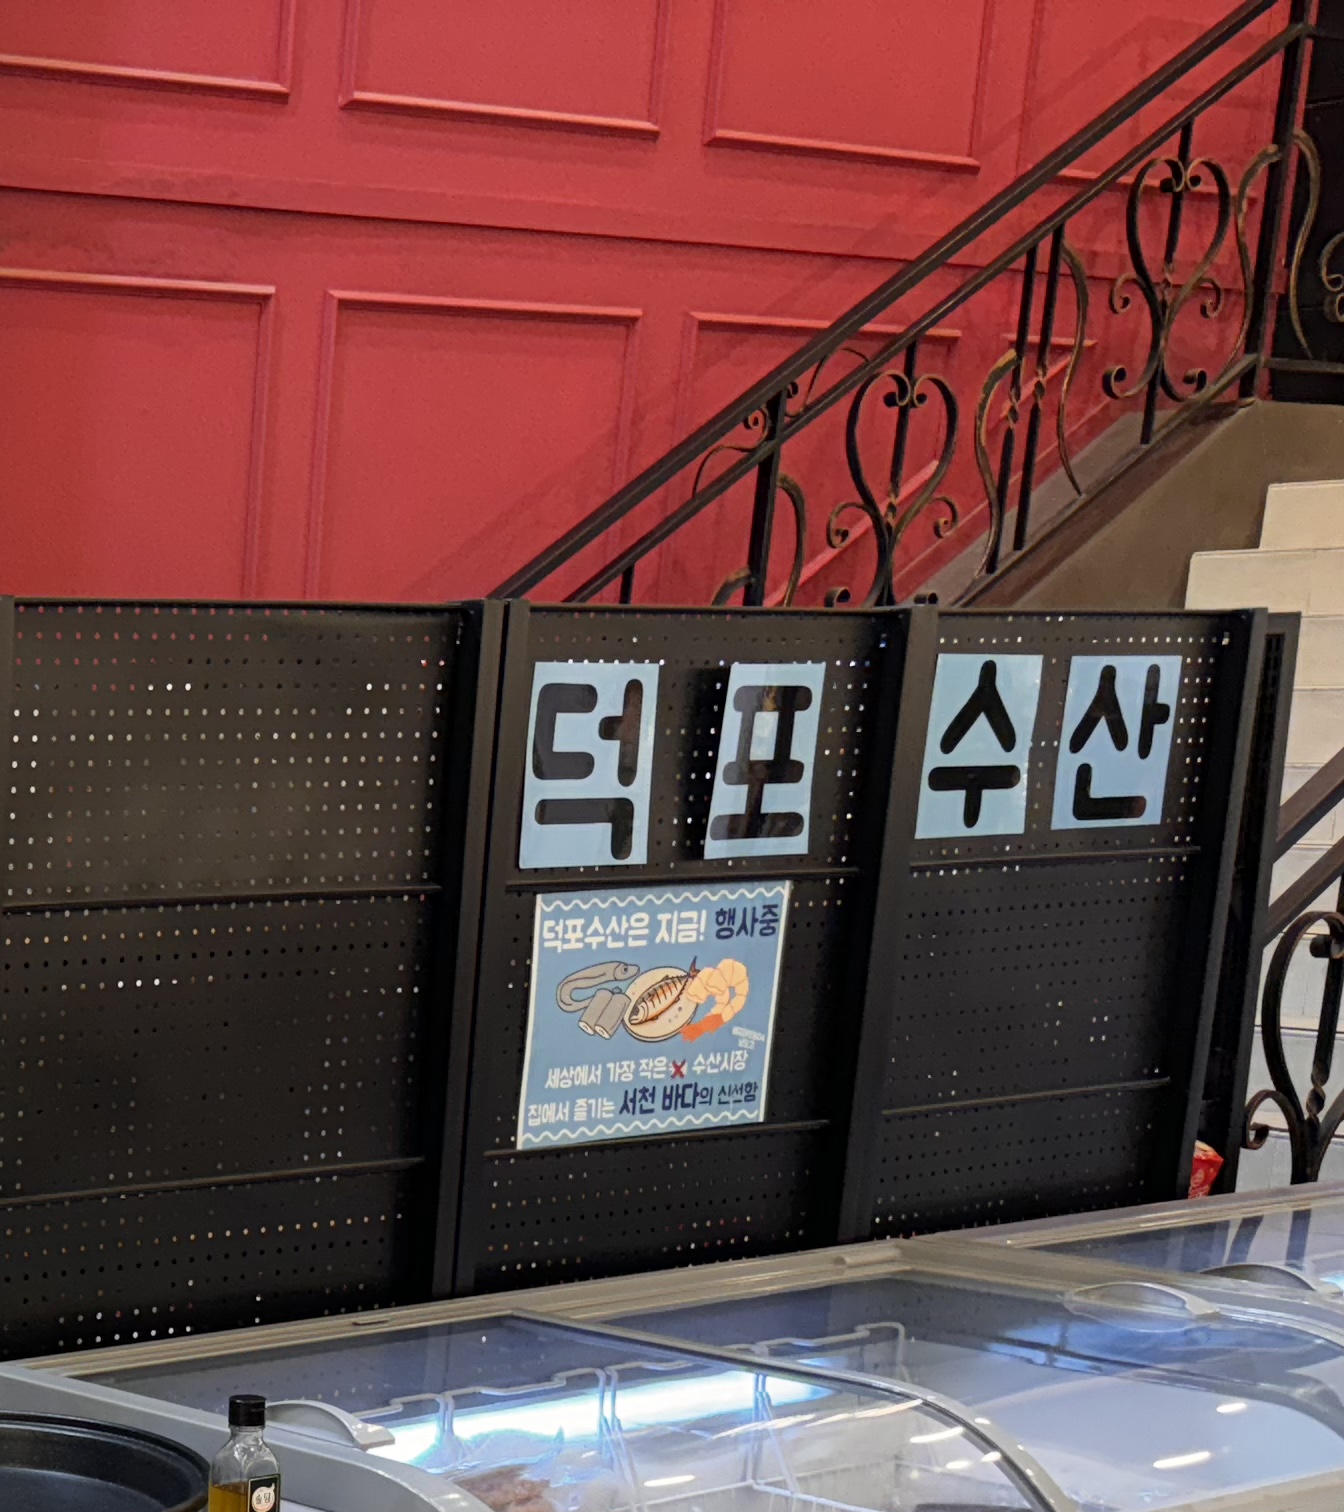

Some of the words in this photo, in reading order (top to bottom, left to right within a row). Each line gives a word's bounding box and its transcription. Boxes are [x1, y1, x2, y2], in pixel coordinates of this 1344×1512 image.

[543, 914, 649, 953] 덕포수산은
[655, 910, 707, 944] 지금!
[715, 904, 779, 940] 행사중
[545, 1064, 602, 1088] 세상에서
[607, 1061, 635, 1082] 가장
[639, 1057, 667, 1079] 작은
[692, 1050, 748, 1075] 수산시장
[528, 1102, 569, 1126] 집에서
[574, 1097, 615, 1121] 즐기는
[619, 1085, 655, 1115] 서천
[662, 1083, 712, 1111] 바다의
[718, 1082, 758, 1105] 신선함
